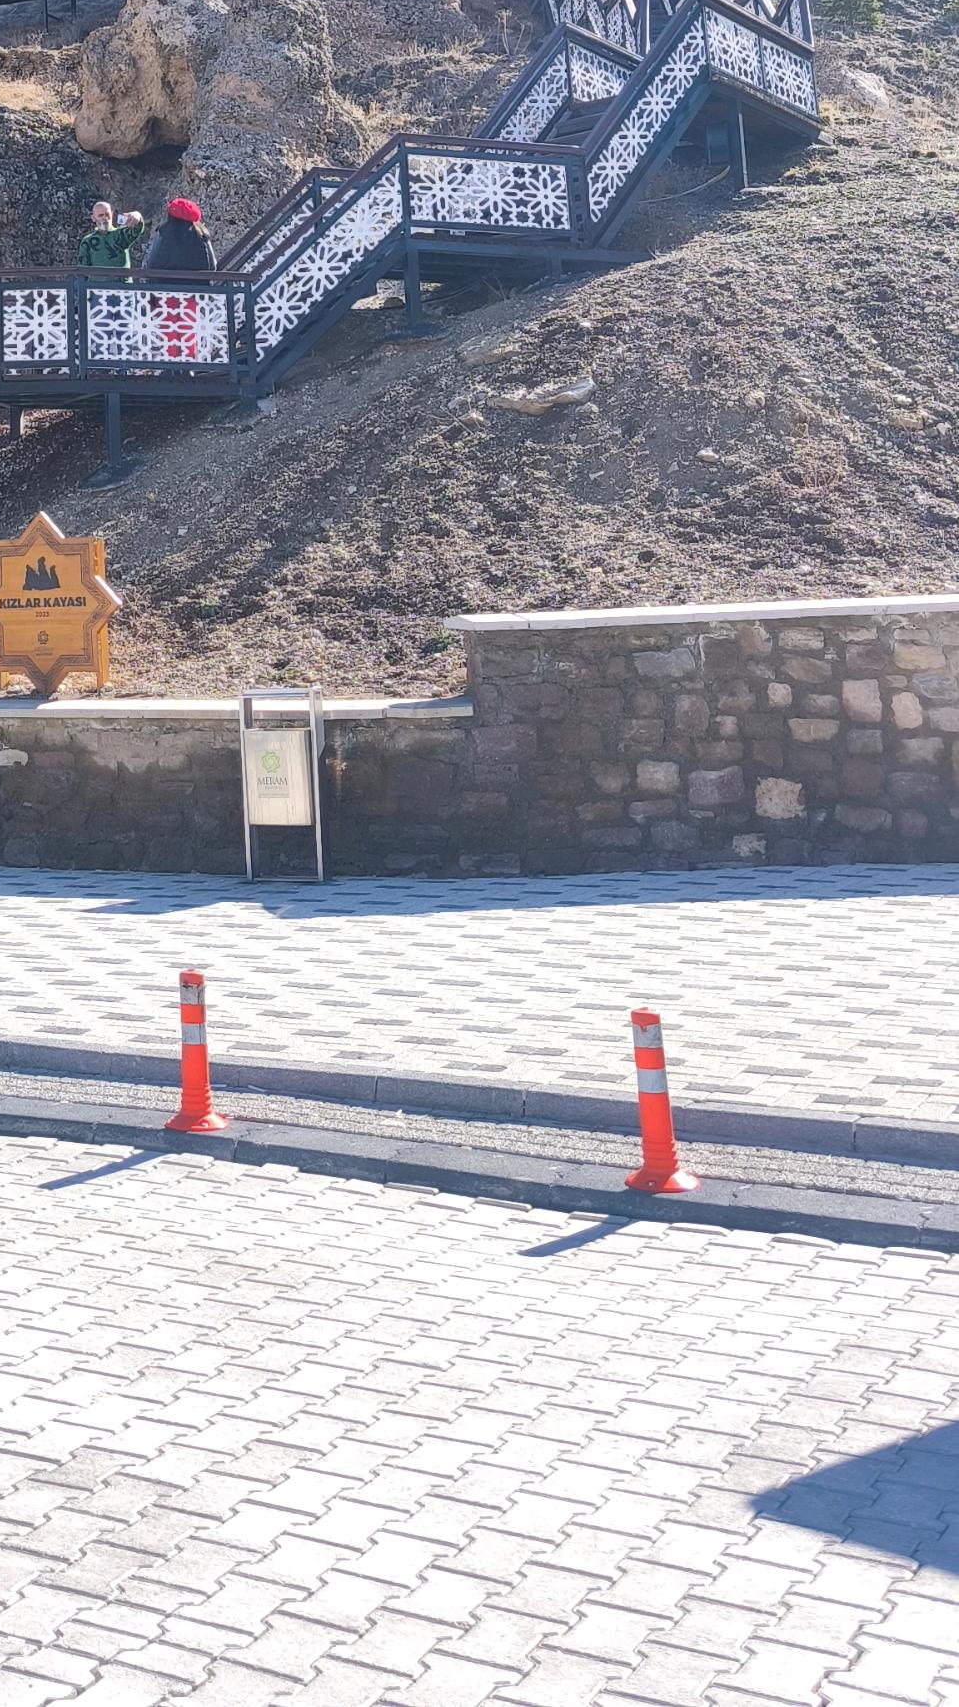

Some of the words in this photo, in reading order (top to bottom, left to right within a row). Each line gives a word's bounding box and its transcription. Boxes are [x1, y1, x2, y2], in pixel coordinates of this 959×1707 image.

[0, 597, 41, 609] KIZLAR
[43, 596, 87, 608] KAYASI
[257, 776, 288, 786] MERAM
